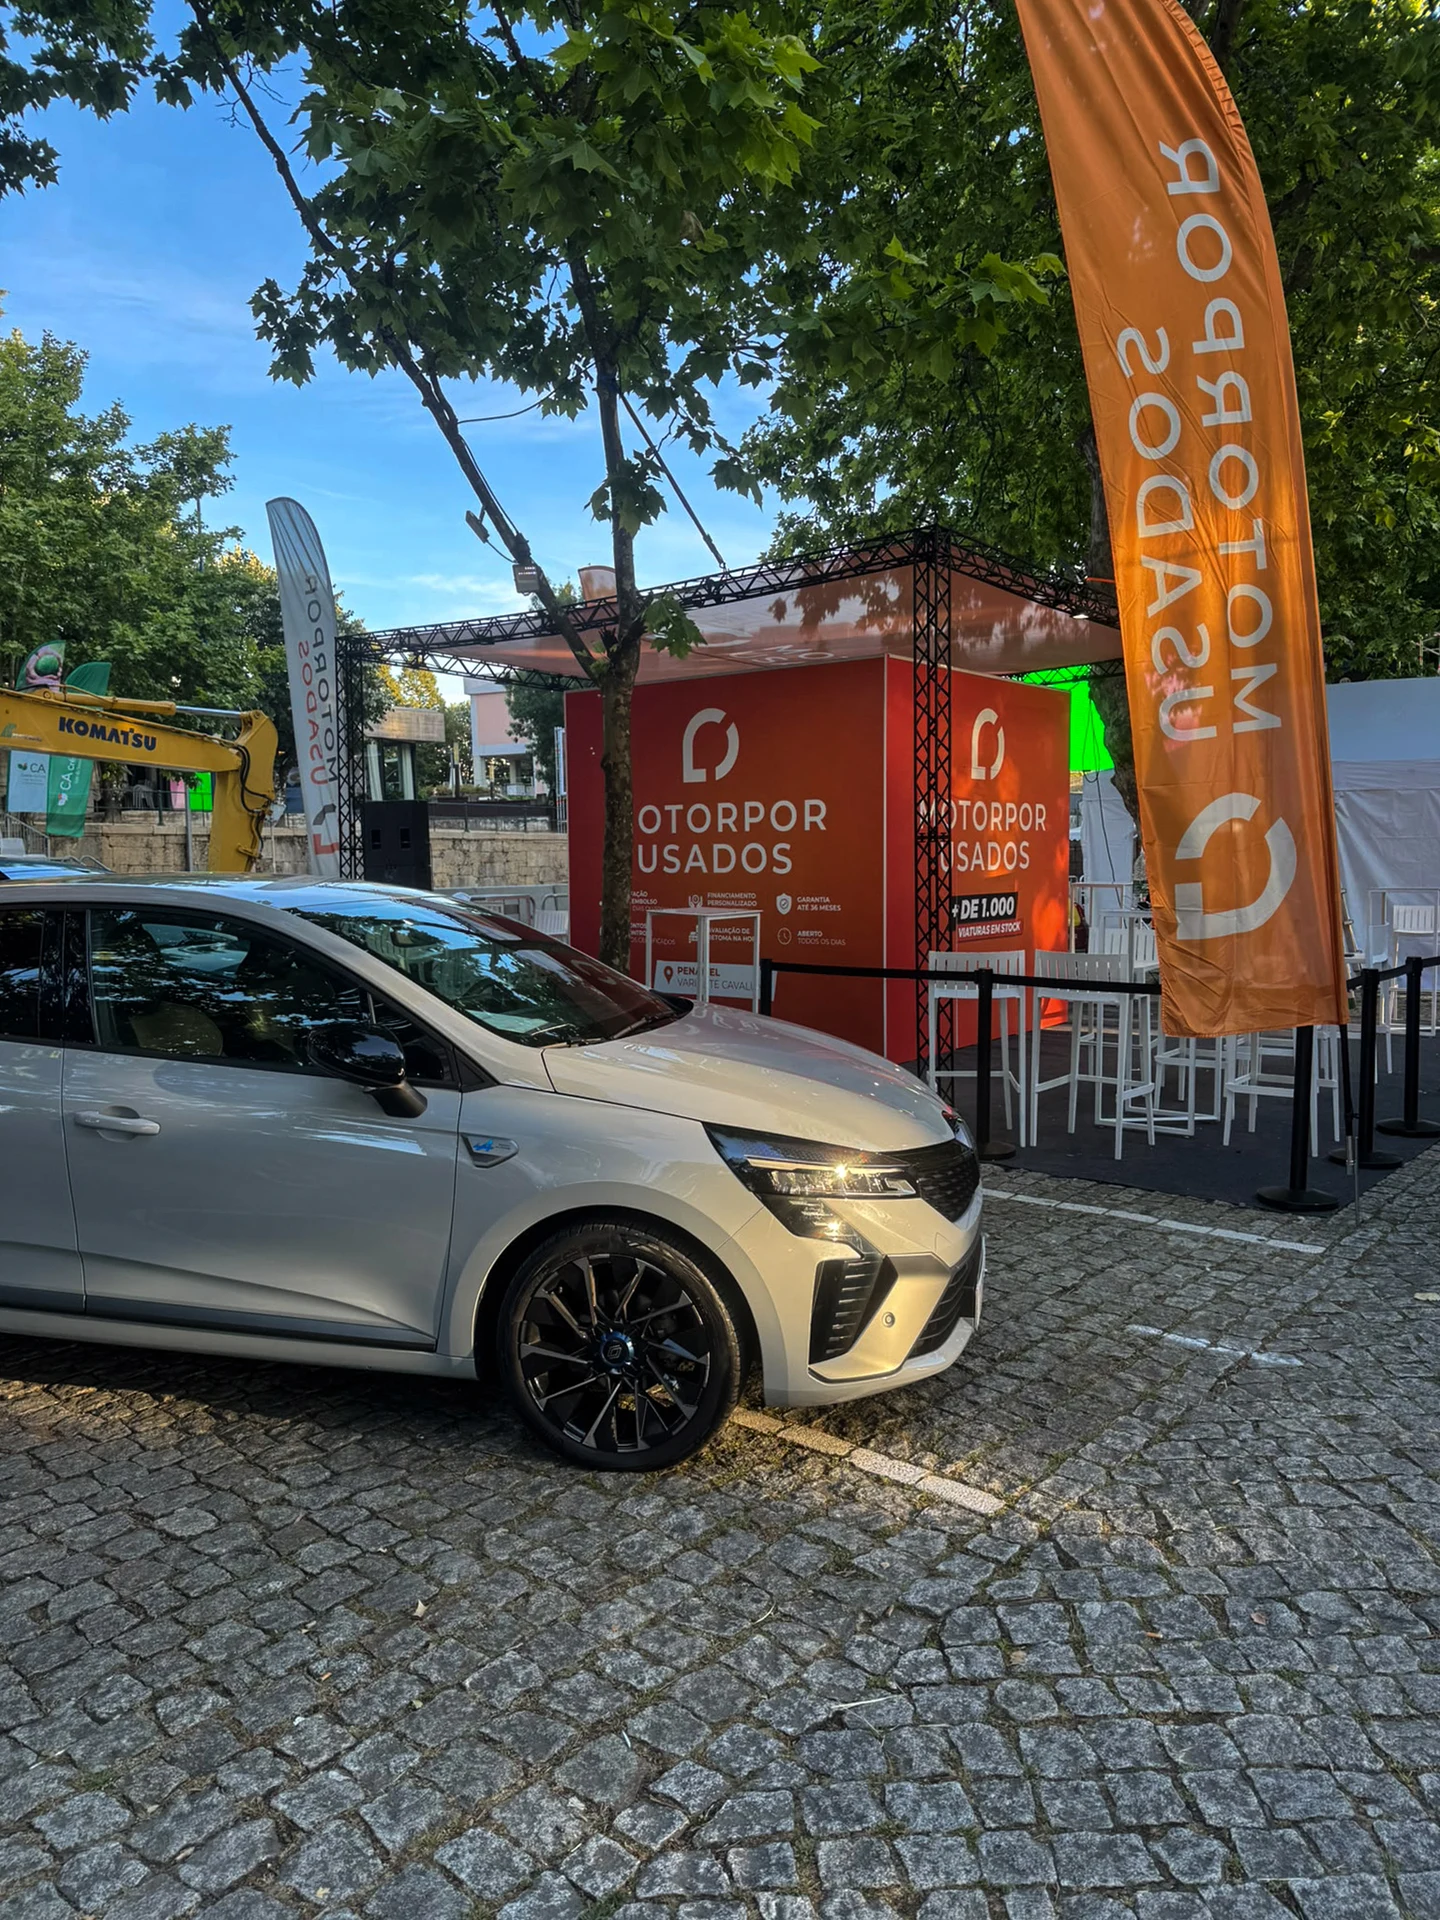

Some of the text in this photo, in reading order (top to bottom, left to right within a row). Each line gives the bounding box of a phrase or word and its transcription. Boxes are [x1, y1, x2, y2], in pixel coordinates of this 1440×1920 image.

[59, 716, 157, 751] KOMATSU
[30, 763, 46, 773] CA
[638, 799, 827, 834] OTORPOR
[637, 842, 792, 874] USADOS
[940, 841, 1030, 872] USADOS
[707, 892, 756, 900] FINANCIAMENTO
[797, 903, 811, 911] ATÉ
[819, 904, 842, 912] MESES
[960, 898, 980, 920] DE
[981, 896, 1014, 918] 1.000
[958, 921, 1021, 938] VIATURAS EM STOCK
[677, 966, 720, 977] PENEL
[677, 978, 720, 989] VARITE
